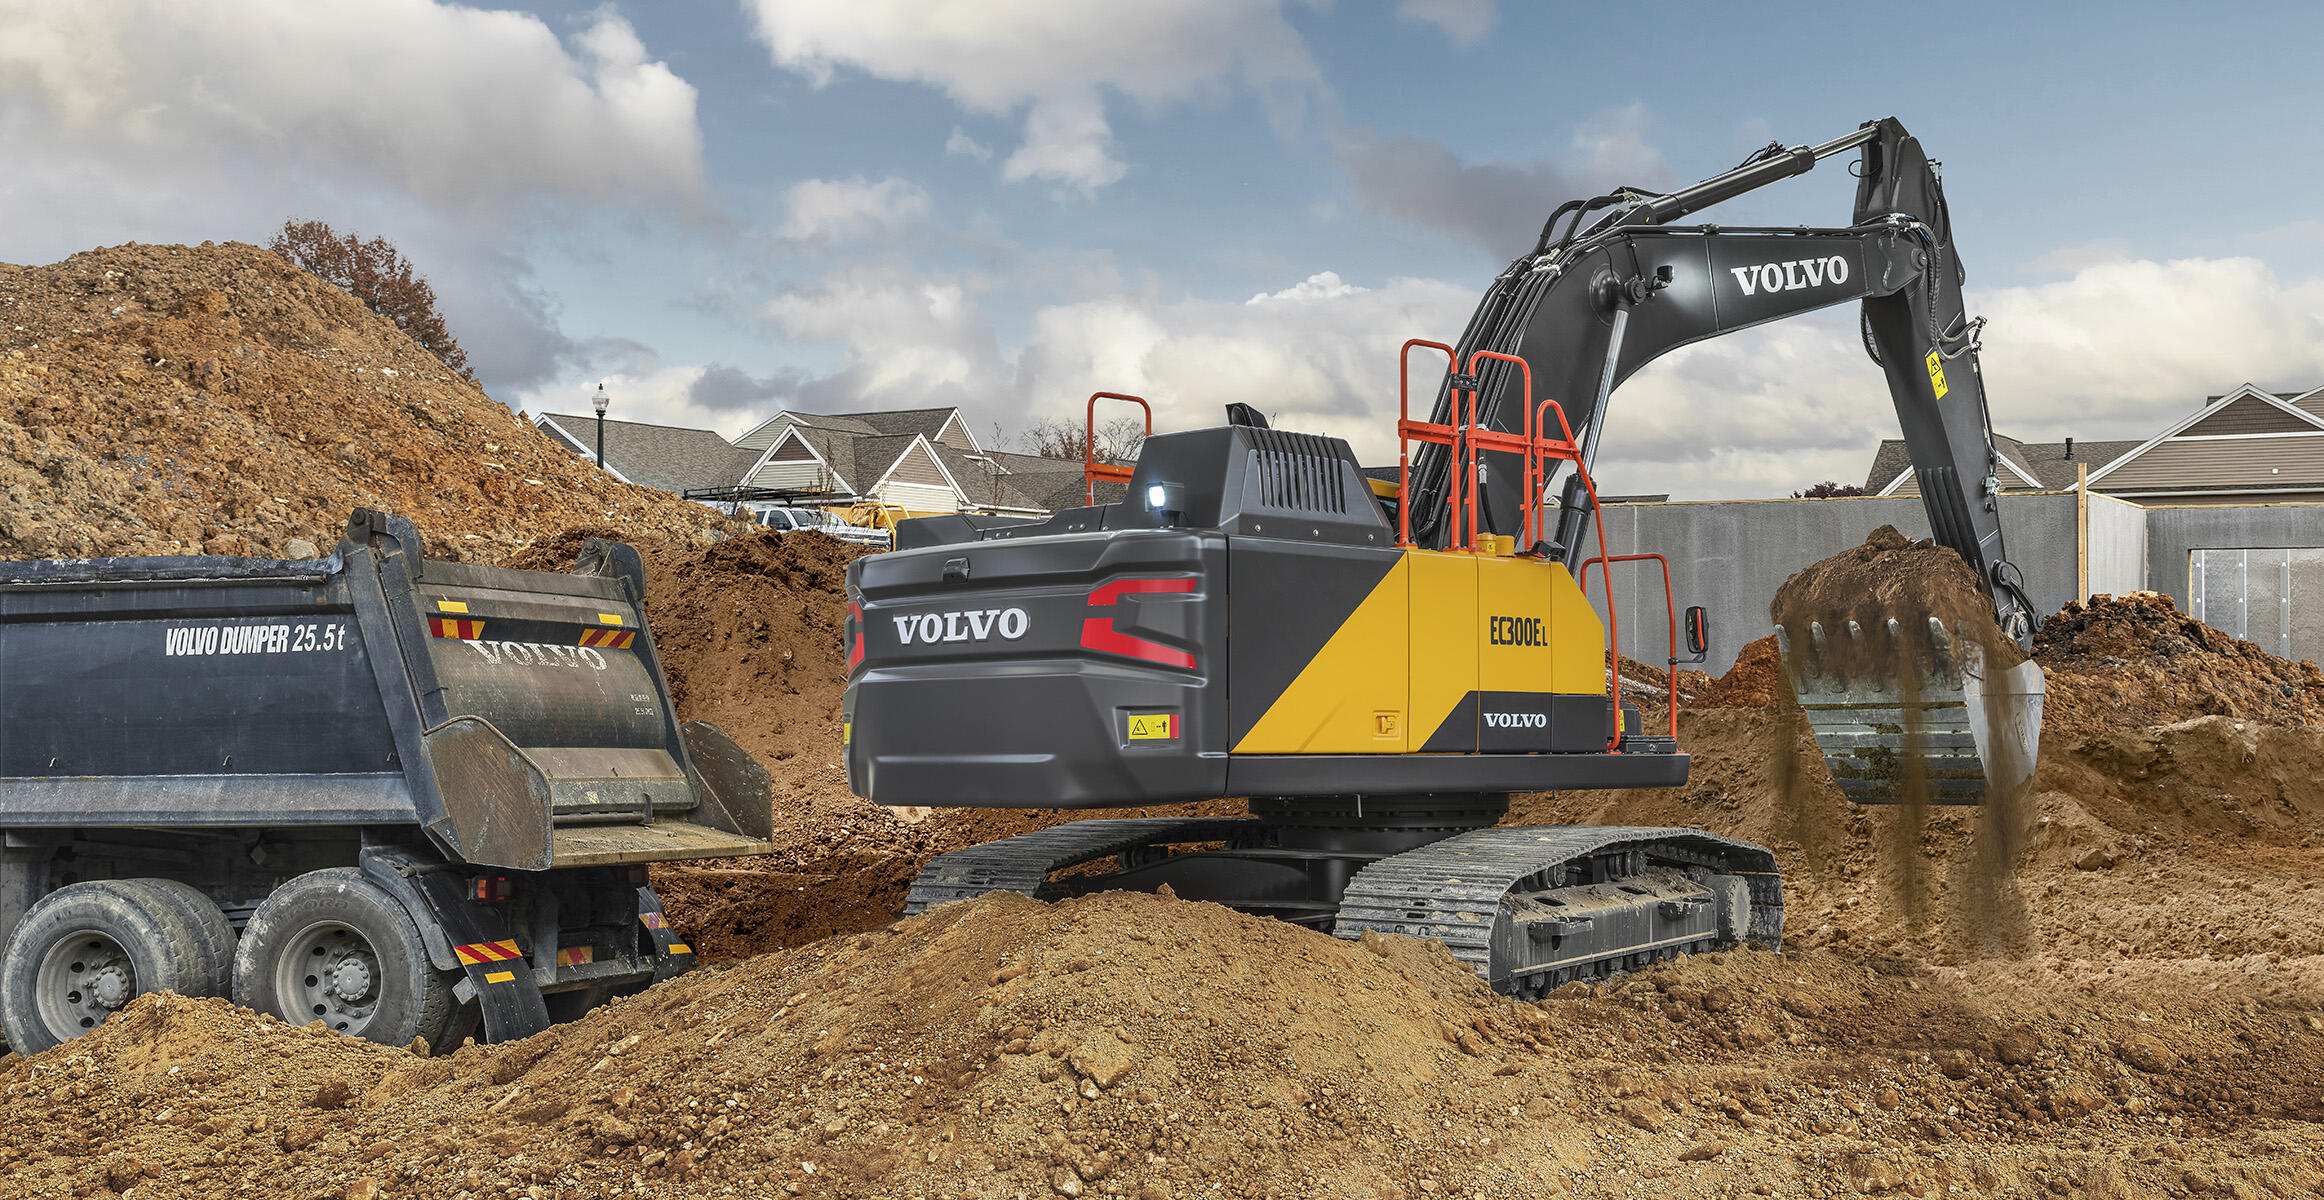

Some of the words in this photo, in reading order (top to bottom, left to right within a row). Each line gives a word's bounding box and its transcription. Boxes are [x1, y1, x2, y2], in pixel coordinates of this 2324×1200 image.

[1730, 255, 1849, 296] VOLVO
[165, 626, 219, 657] VOLVO
[219, 624, 290, 655] DUMPER
[892, 607, 1028, 645] VOLVO
[462, 639, 608, 671] VOLVO
[1483, 713, 1547, 728] VOLVO
